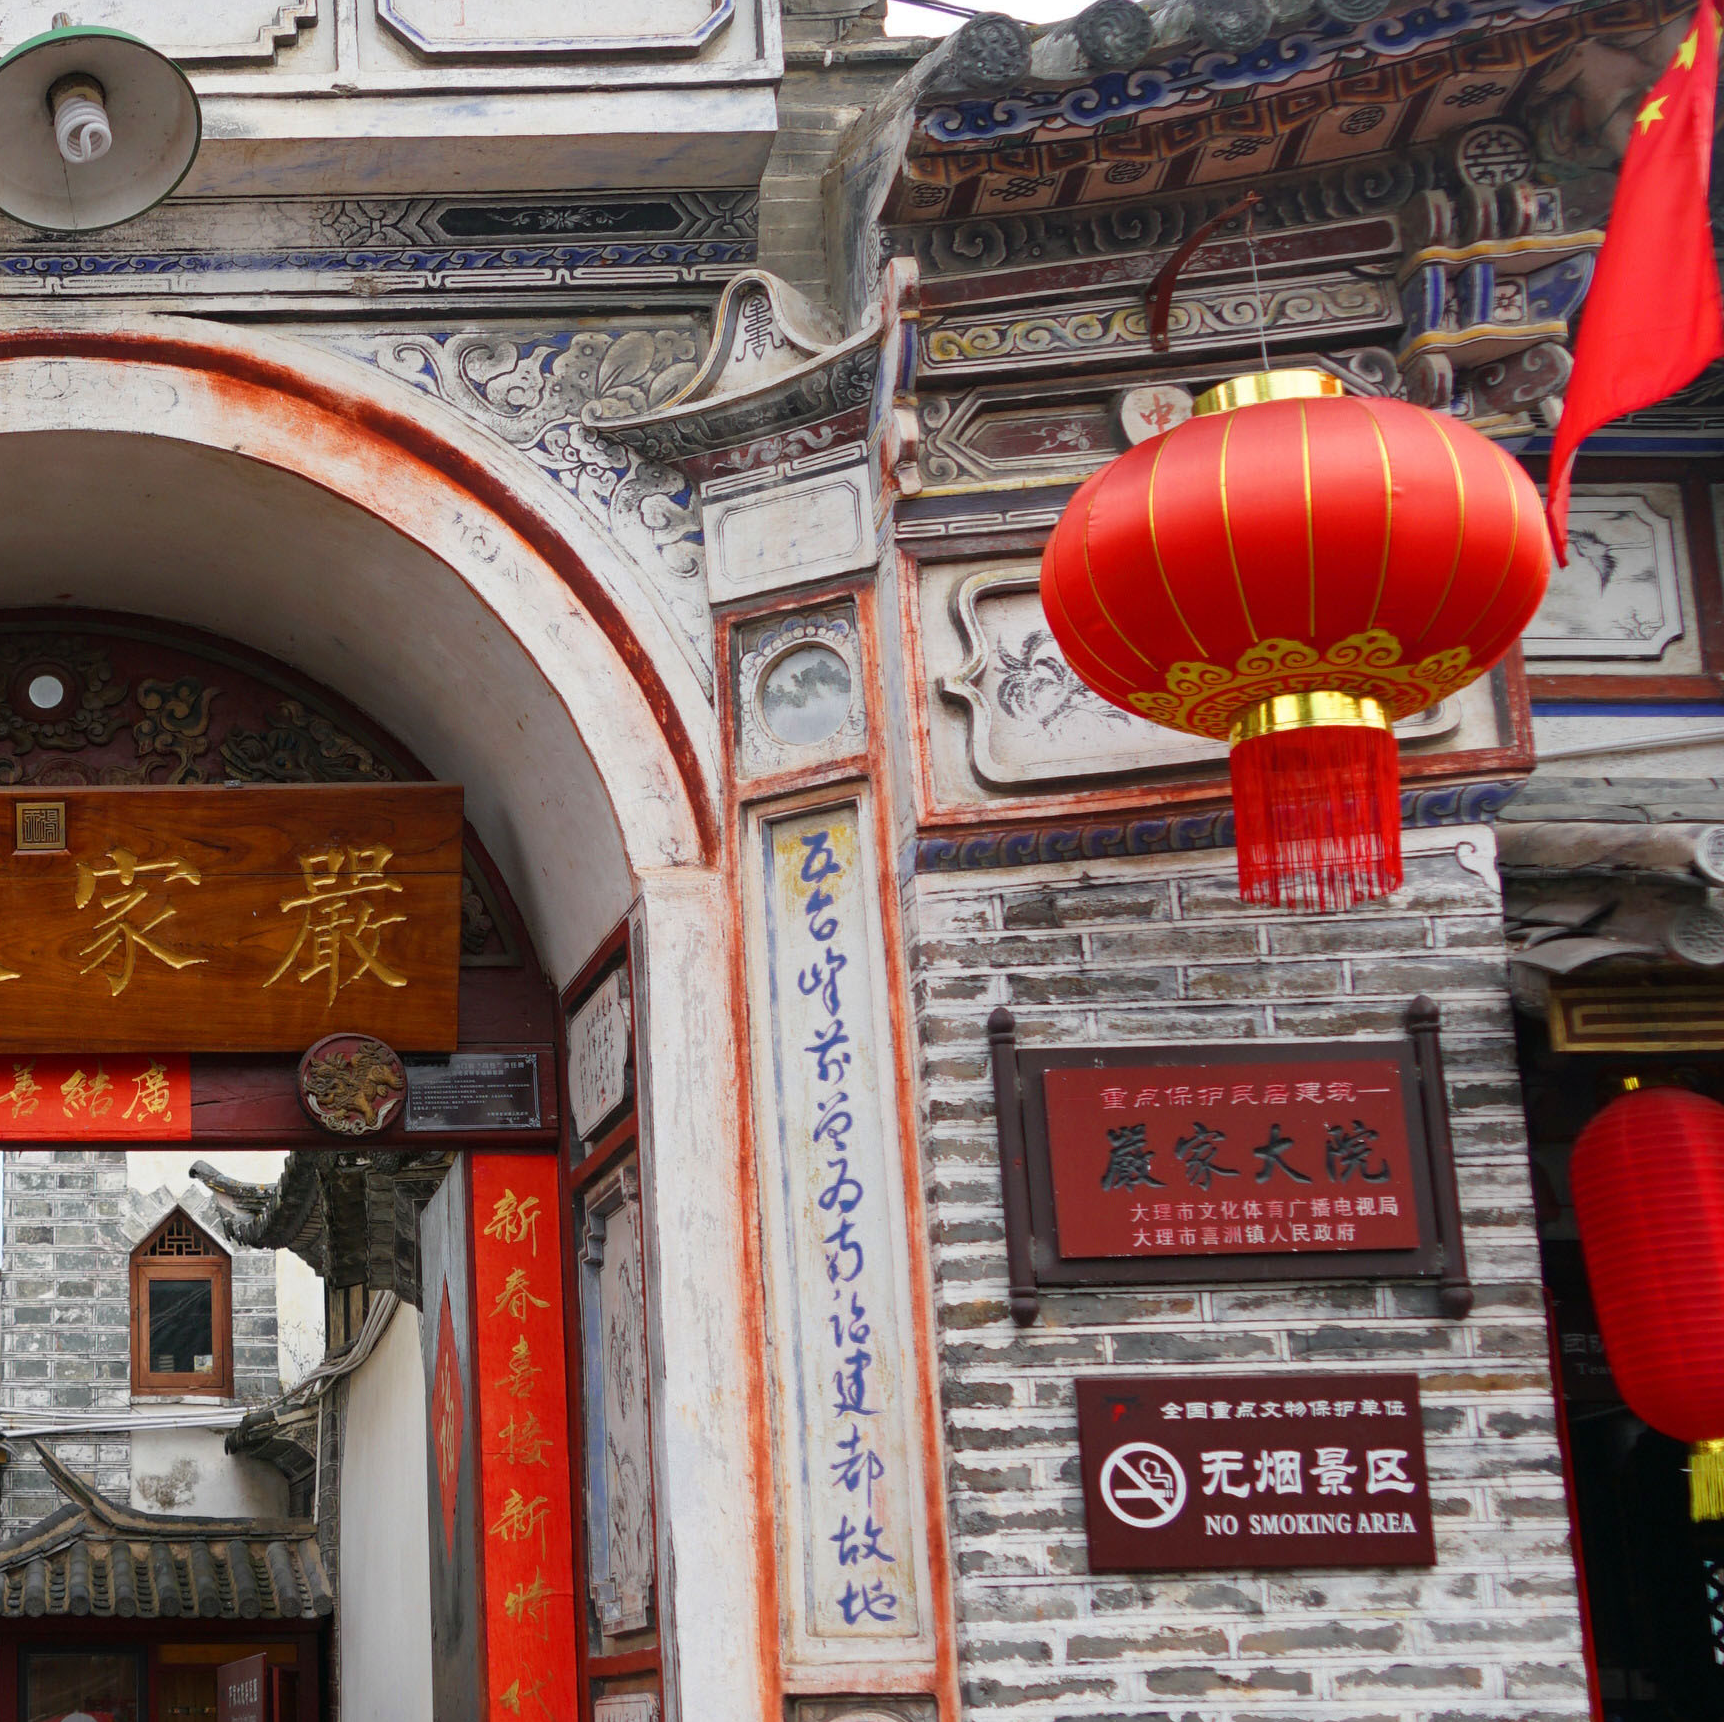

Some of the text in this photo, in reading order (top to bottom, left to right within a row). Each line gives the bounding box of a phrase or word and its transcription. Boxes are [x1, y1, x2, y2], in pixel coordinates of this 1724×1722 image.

[1129, 1196, 1399, 1224] 大理市文化体育广播电视局
[1132, 1222, 1357, 1248] 大理市喜洲镇人民政府
[1159, 1399, 1407, 1420] 全国重点文物保护单位
[1199, 1447, 1416, 1499] 无烟景区
[1204, 1512, 1417, 1536] NO SMOKING AREA
